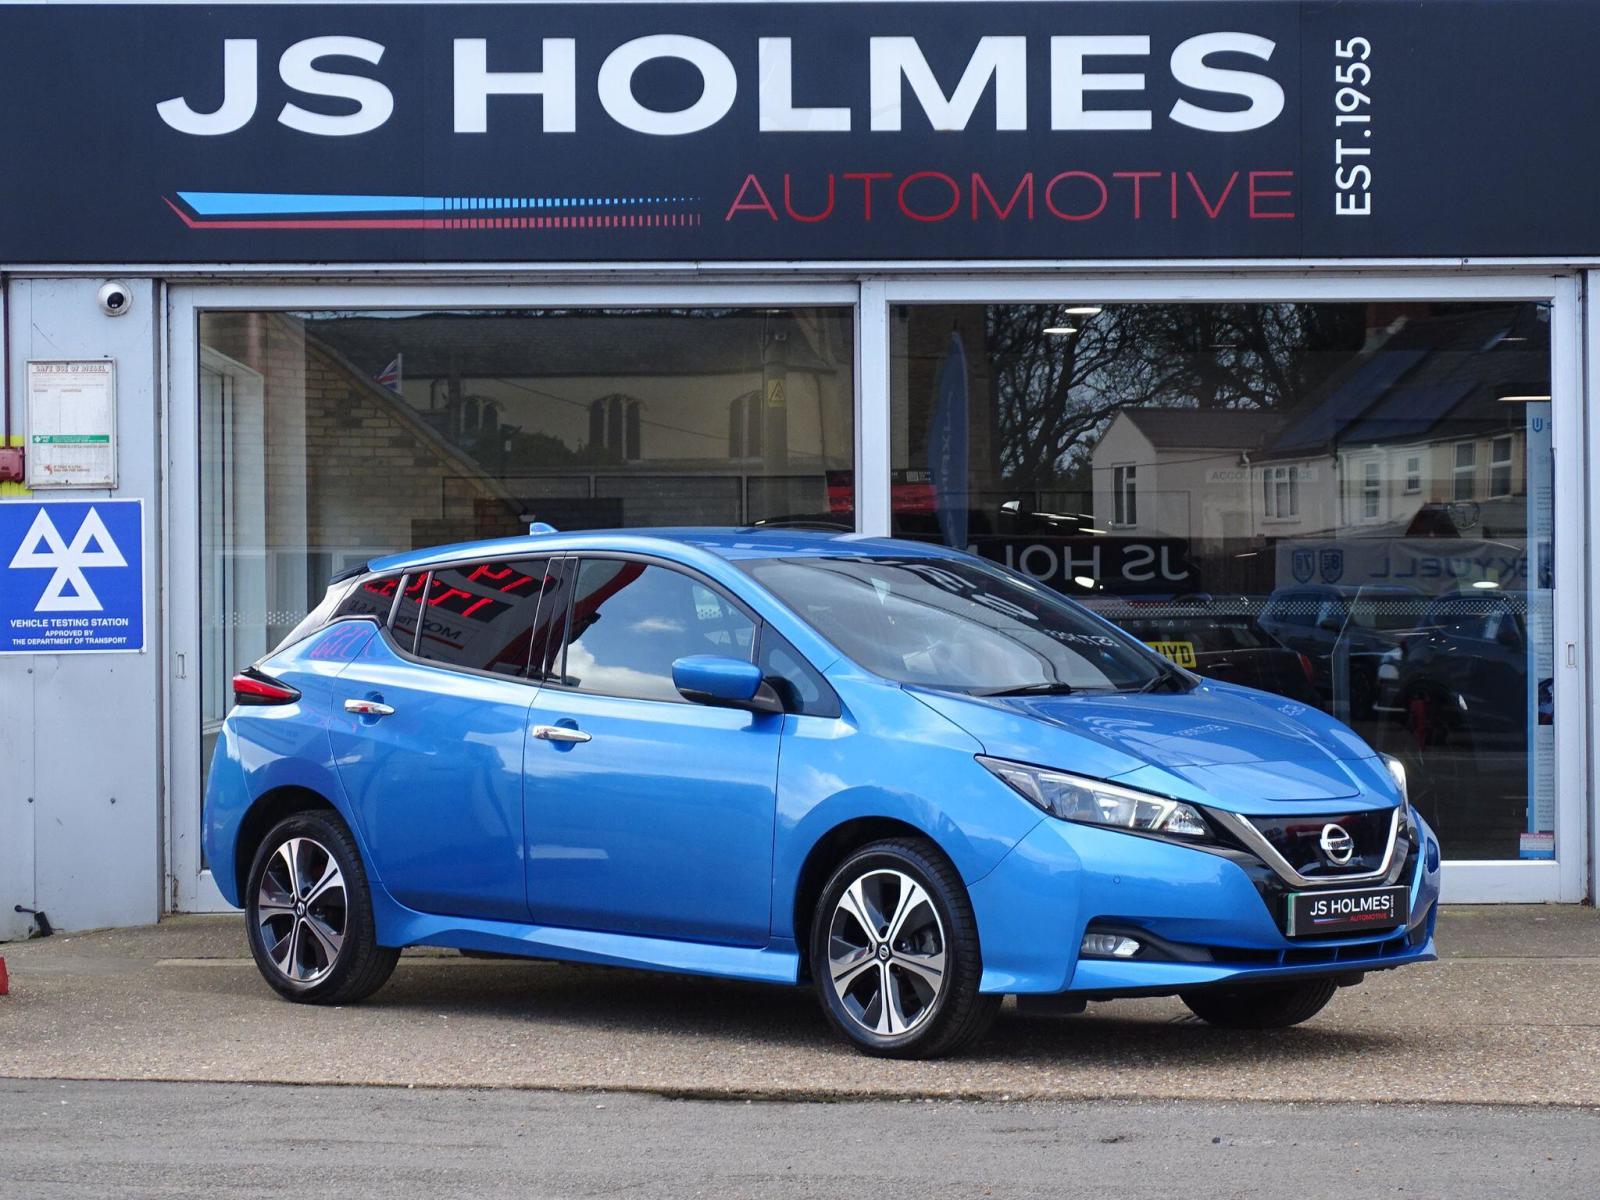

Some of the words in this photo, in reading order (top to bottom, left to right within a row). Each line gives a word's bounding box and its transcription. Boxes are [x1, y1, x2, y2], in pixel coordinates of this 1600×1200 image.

[156, 35, 394, 136] JS
[453, 32, 1286, 136] HOLMES
[1335, 36, 1372, 216] EST.1955
[725, 170, 1295, 223] AUTOMOTIVE
[10, 619, 49, 628] VEHICLE
[50, 618, 89, 627] TESTING
[90, 617, 129, 626] STATION
[1118, 619, 1192, 628] ISSAN
[1309, 900, 1328, 916] JS
[1331, 895, 1390, 914] HOLMES
[1349, 912, 1387, 922] AUTOMOTIVE
